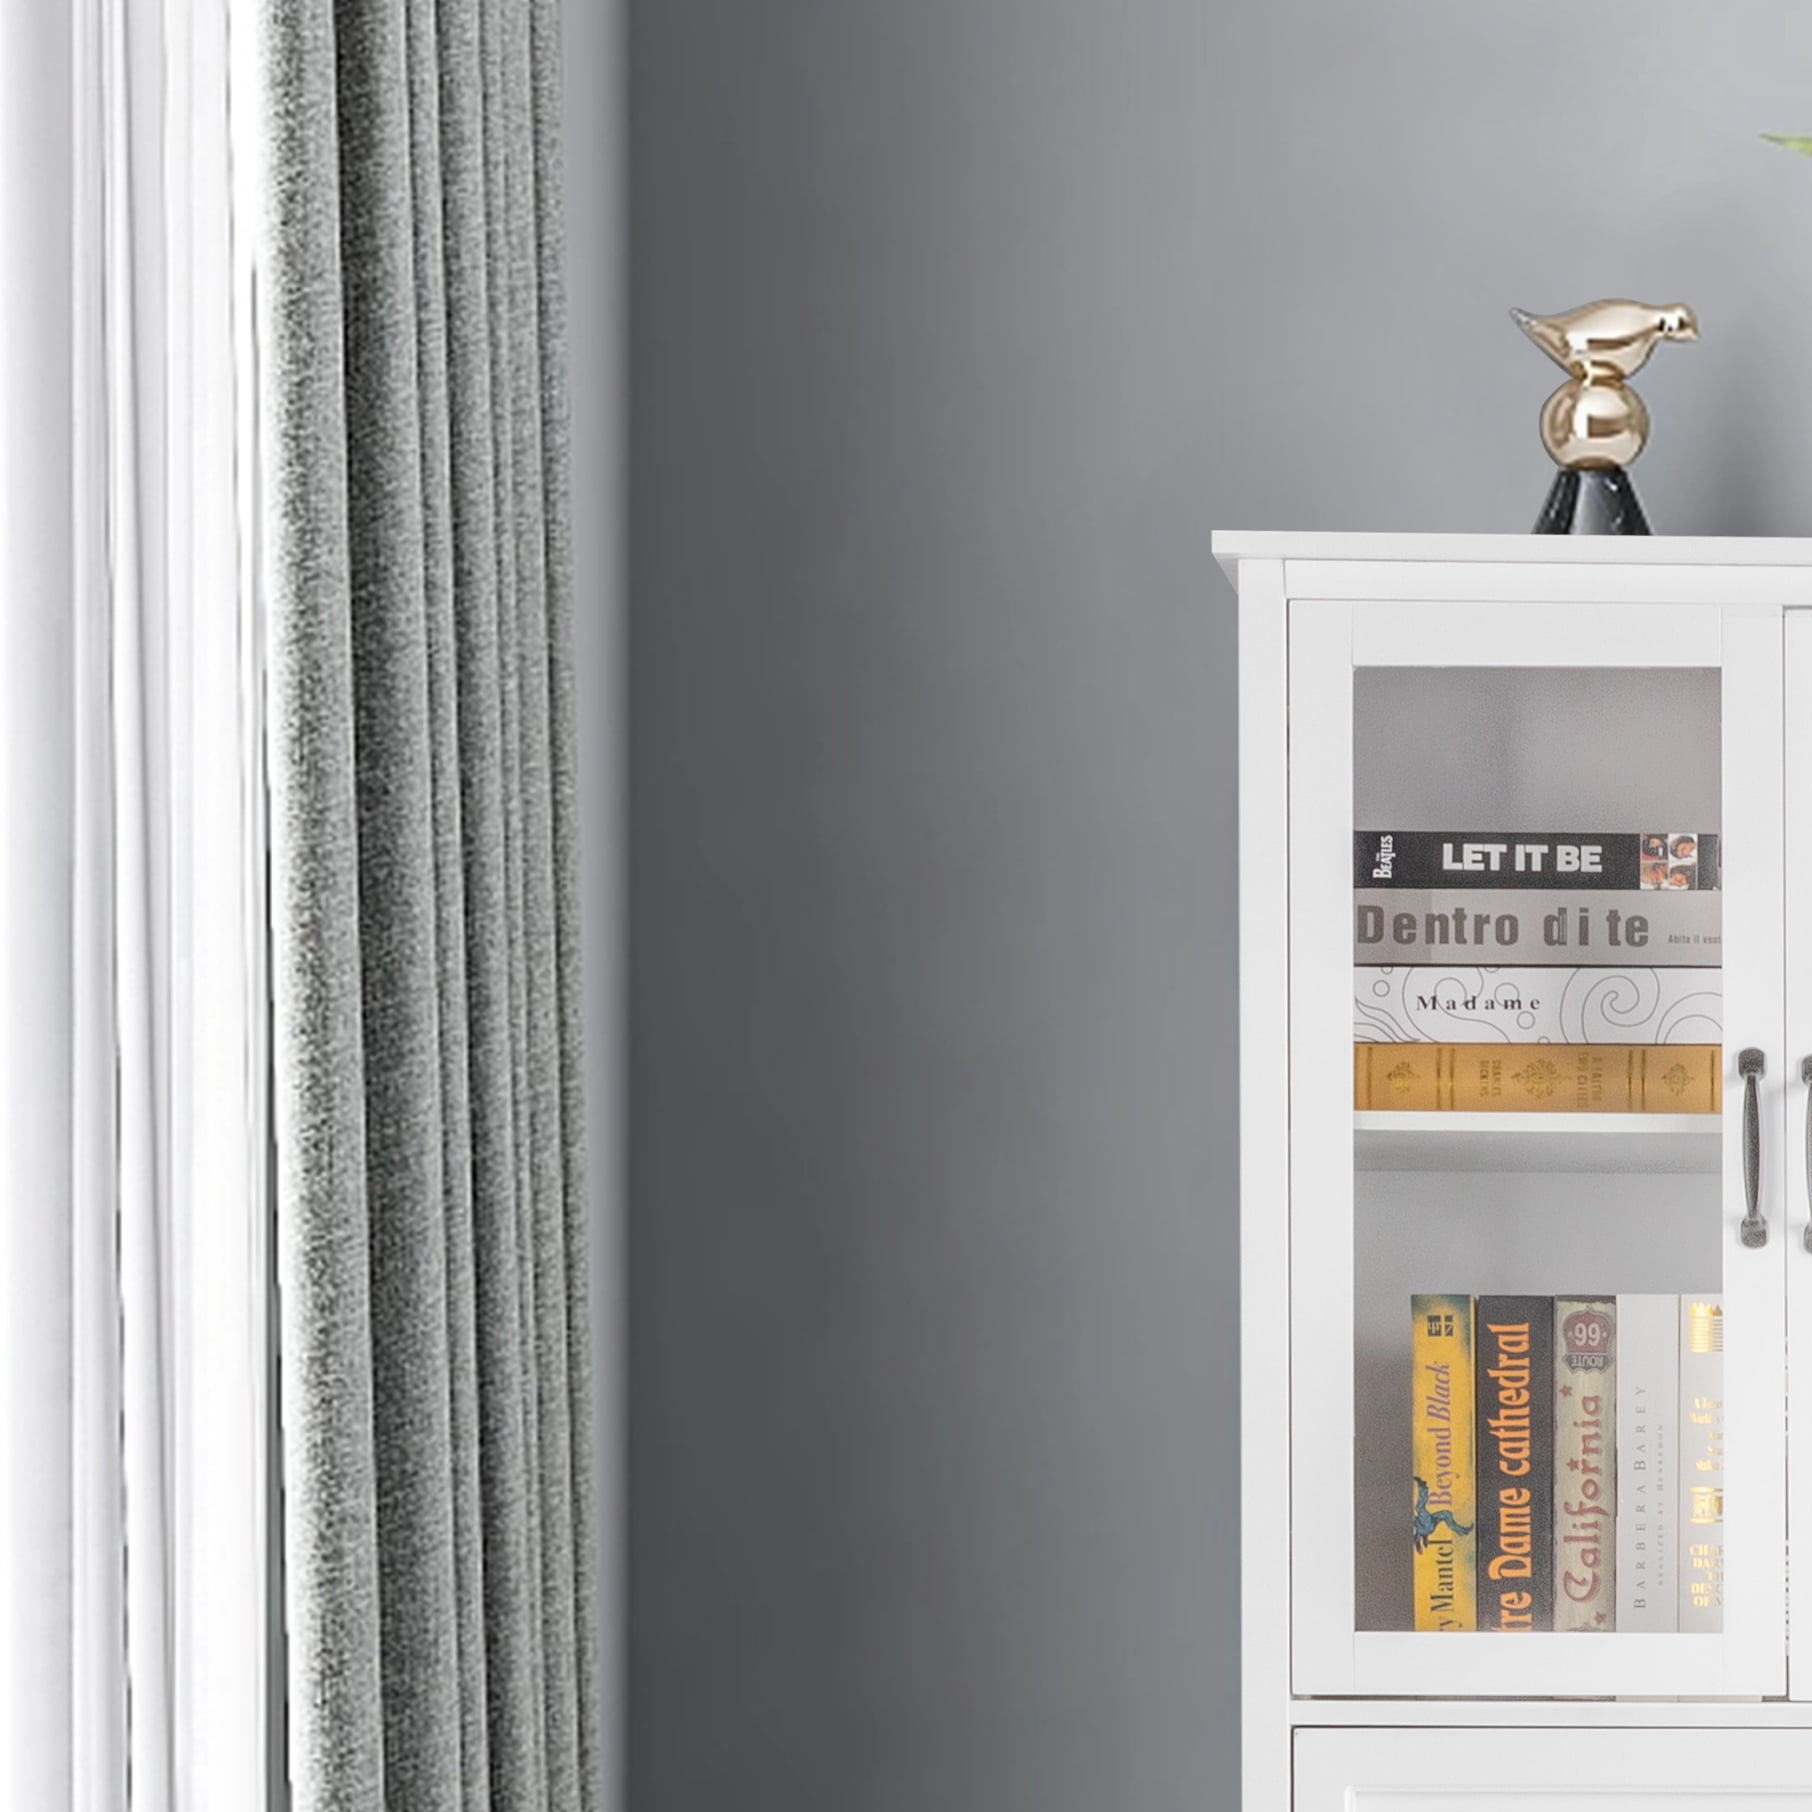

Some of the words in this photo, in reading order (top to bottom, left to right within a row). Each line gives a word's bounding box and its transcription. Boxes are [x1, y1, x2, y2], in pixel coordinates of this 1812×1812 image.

[1373, 835, 1396, 878] BEATLES
[1442, 843, 1506, 870] LET
[1515, 844, 1549, 871] IT
[1556, 846, 1603, 873] BE
[1356, 905, 1520, 946] Dentro
[1543, 907, 1590, 947] di
[1606, 909, 1650, 947] te
[1416, 995, 1541, 1011] Madame
[1426, 1360, 1451, 1423] Black
[1486, 1322, 1532, 1477] cathedral
[1571, 1355, 1604, 1368] ROUTE
[1633, 1386, 1646, 1471] BAREY
[1428, 1427, 1460, 1510] Beyond
[1563, 1394, 1609, 1603] California
[1488, 1487, 1532, 1581] Dame
[1633, 1483, 1646, 1609] BARBERA
[1430, 1537, 1454, 1616] Mantel
